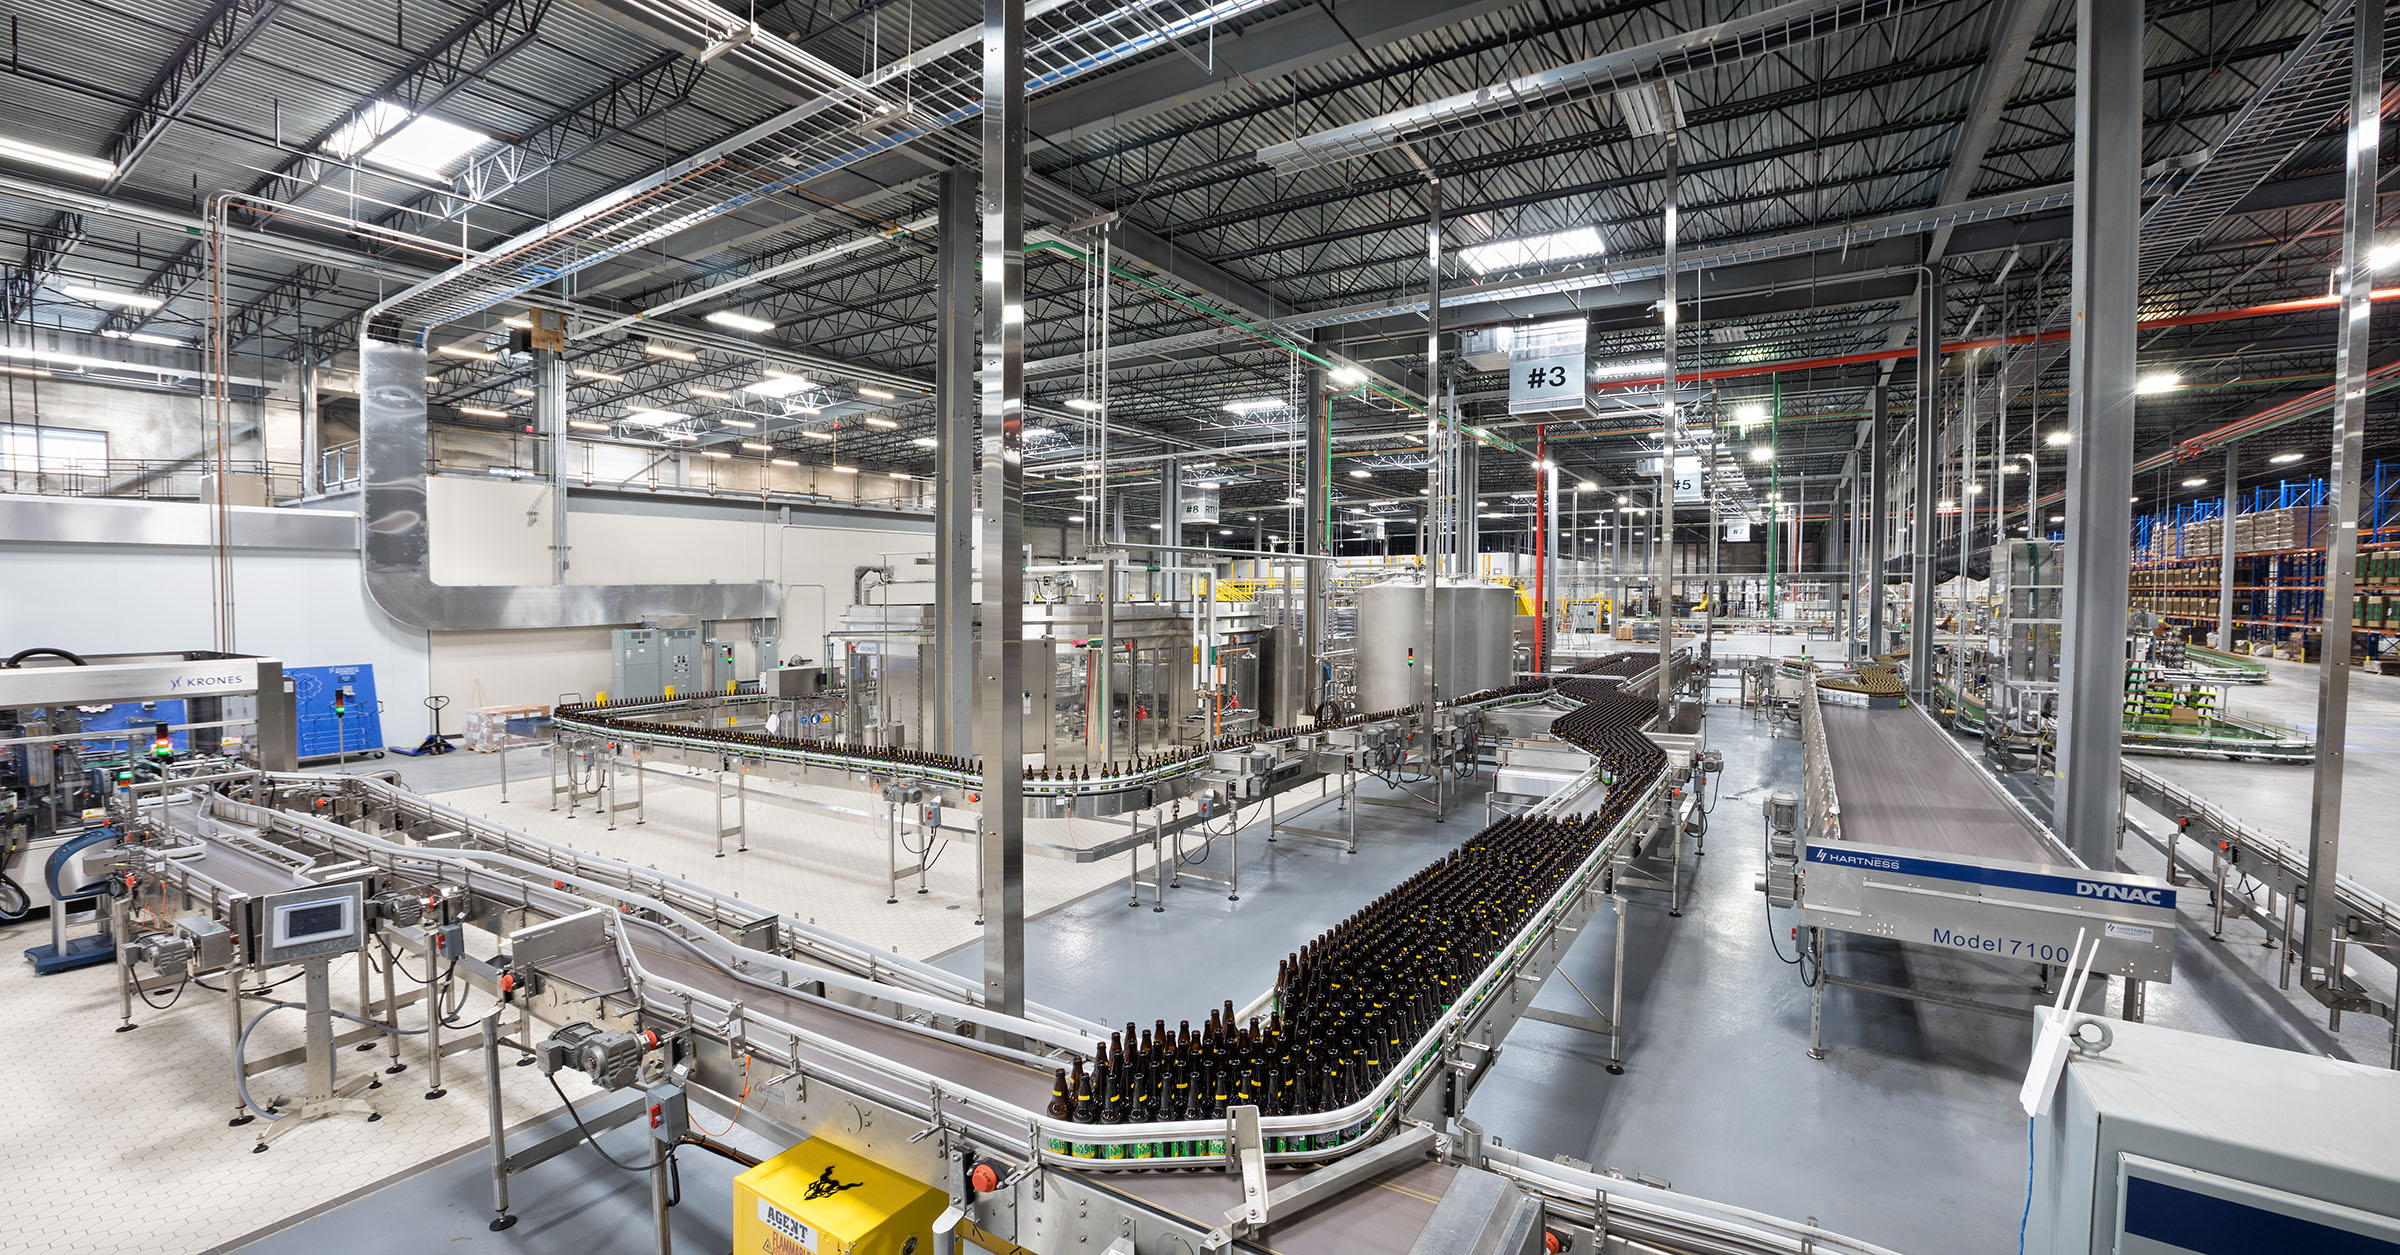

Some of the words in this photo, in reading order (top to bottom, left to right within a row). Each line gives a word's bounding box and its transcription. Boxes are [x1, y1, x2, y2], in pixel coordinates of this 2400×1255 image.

[1527, 366, 1566, 389] #3
[1673, 479, 1691, 490] #5
[1186, 505, 1199, 514] #8
[1205, 505, 1218, 515] RTU
[187, 675, 242, 687] KRONES
[1830, 854, 1900, 870] HARTNESS
[2076, 881, 2161, 905] DYNAC
[1933, 928, 2002, 953] Model
[2009, 939, 2070, 963] 7100
[767, 1206, 808, 1239] AGENT
